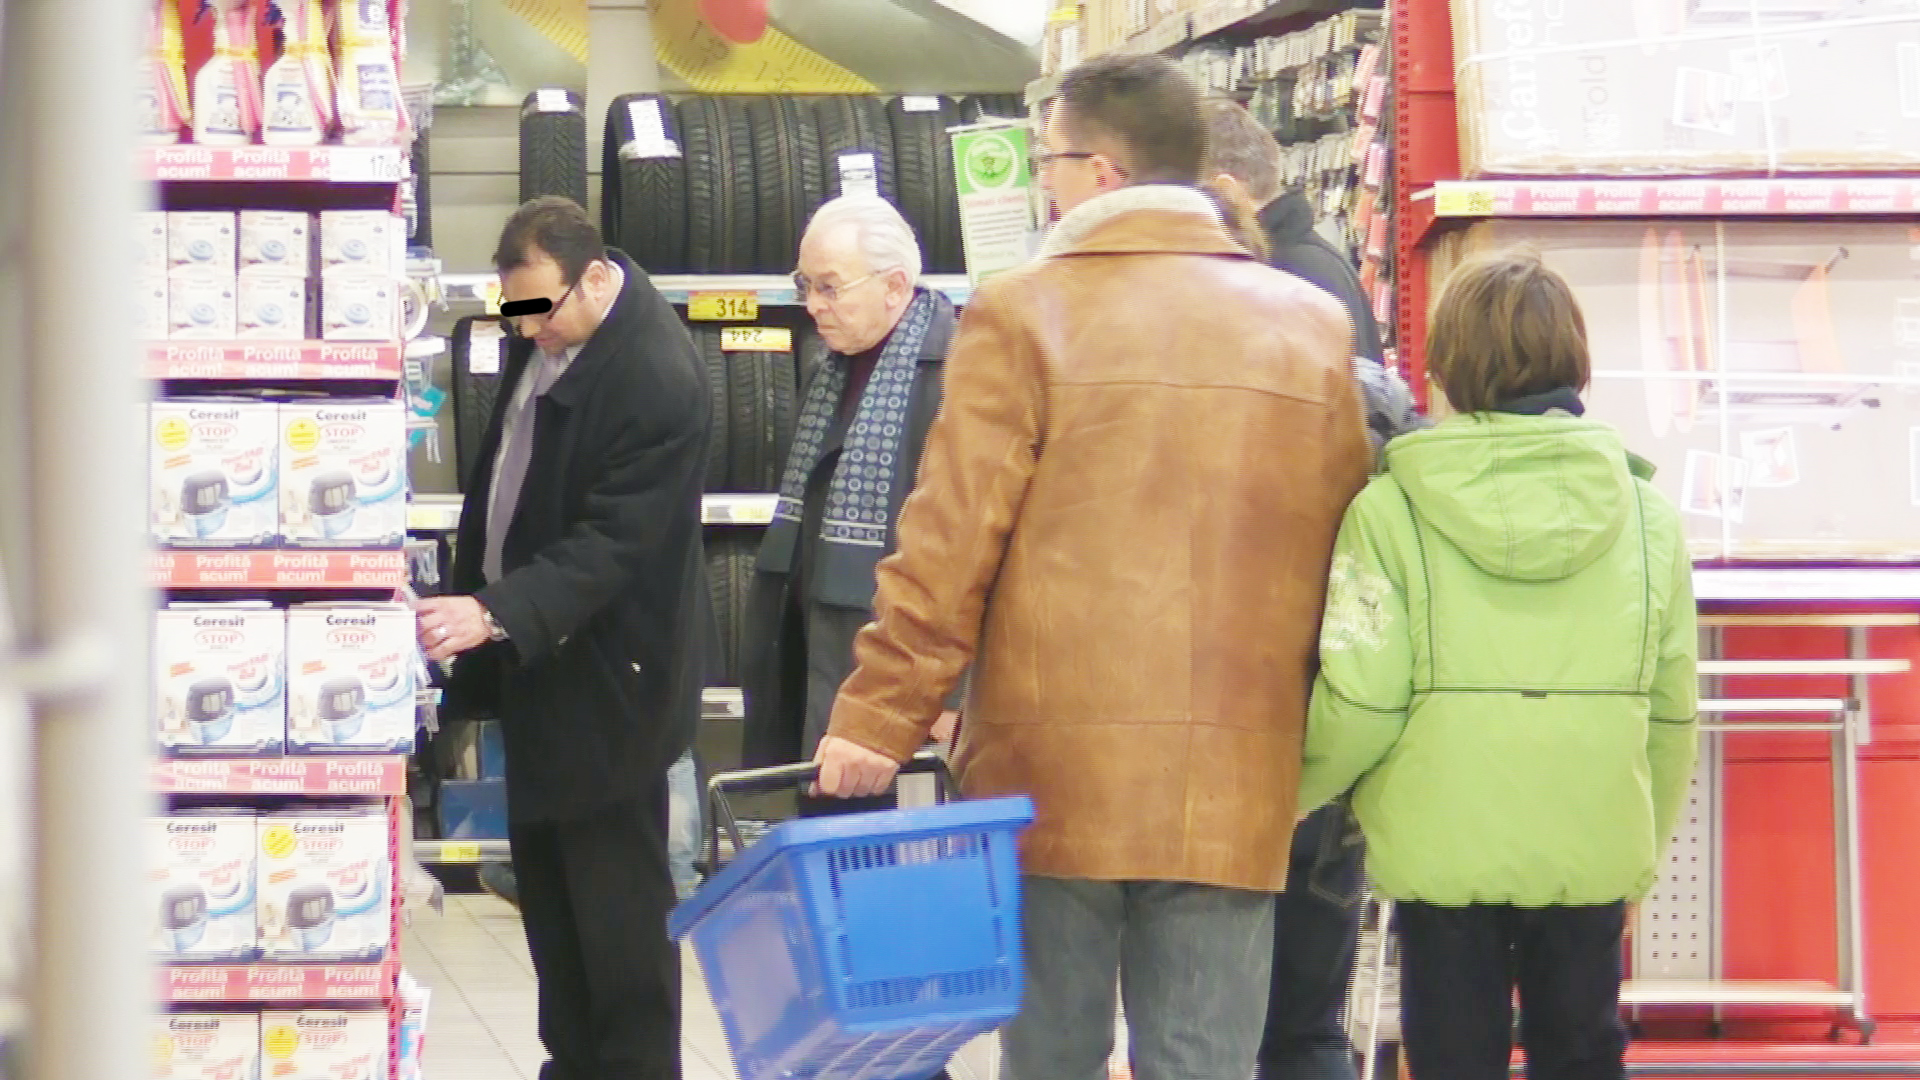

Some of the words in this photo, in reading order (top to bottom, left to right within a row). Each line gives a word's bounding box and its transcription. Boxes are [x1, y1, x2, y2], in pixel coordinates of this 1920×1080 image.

[717, 298, 748, 318] 314
[189, 408, 239, 420] Ceresit
[316, 409, 367, 421] Ceresit
[198, 426, 232, 437] STOP
[325, 427, 359, 438] STOP
[194, 614, 244, 627] Ceresit
[326, 613, 376, 626] Ceresit
[333, 632, 369, 644] STOP
